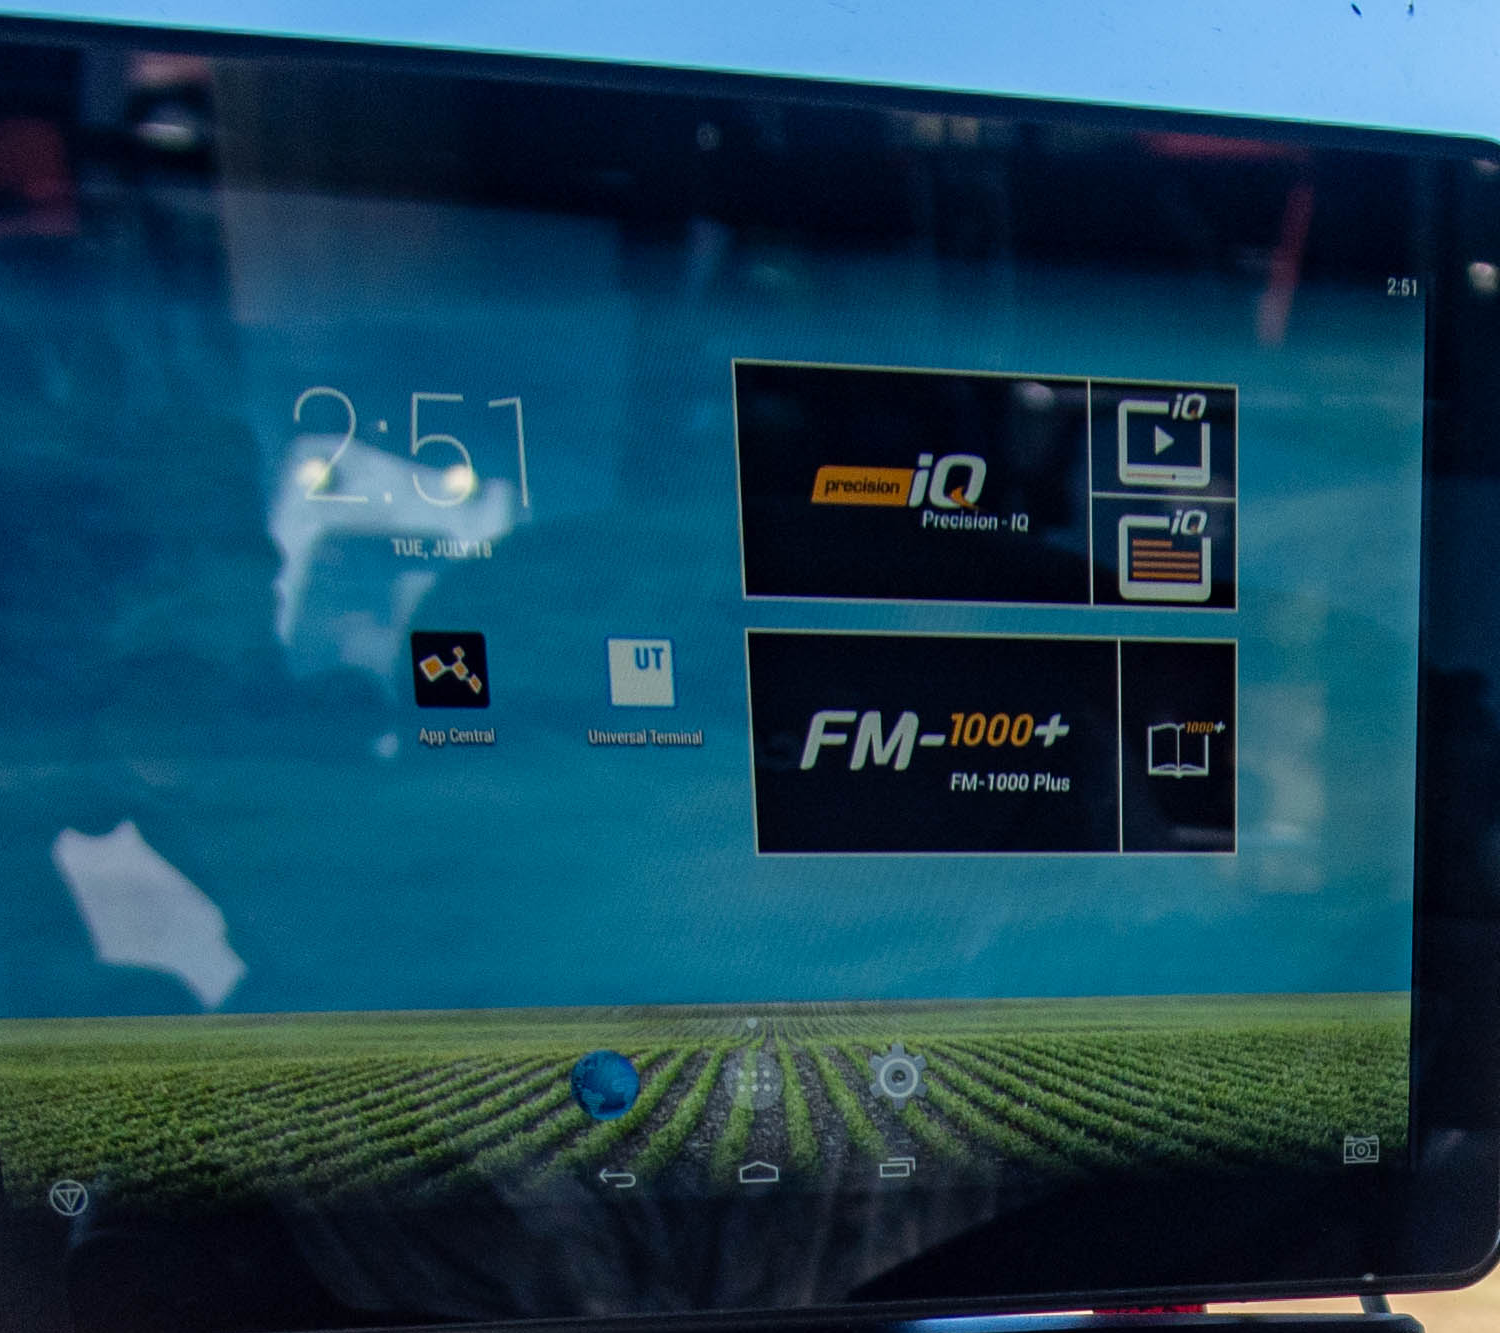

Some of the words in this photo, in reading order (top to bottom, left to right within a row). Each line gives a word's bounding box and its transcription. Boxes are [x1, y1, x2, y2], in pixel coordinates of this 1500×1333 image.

[1387, 277, 1418, 297] 2:51
[294, 386, 528, 507] 2:51
[824, 476, 901, 496] precision
[922, 510, 998, 531] Precision
[1011, 514, 1029, 533] IQ
[392, 538, 428, 560] TUE,
[432, 539, 470, 558] JULY
[634, 647, 664, 669] UT
[418, 728, 446, 745] App
[449, 727, 496, 744] Central
[587, 729, 647, 746] Universal
[650, 730, 703, 745] Terminal
[951, 772, 1029, 792] FM-1000
[1034, 773, 1071, 792] Plus
